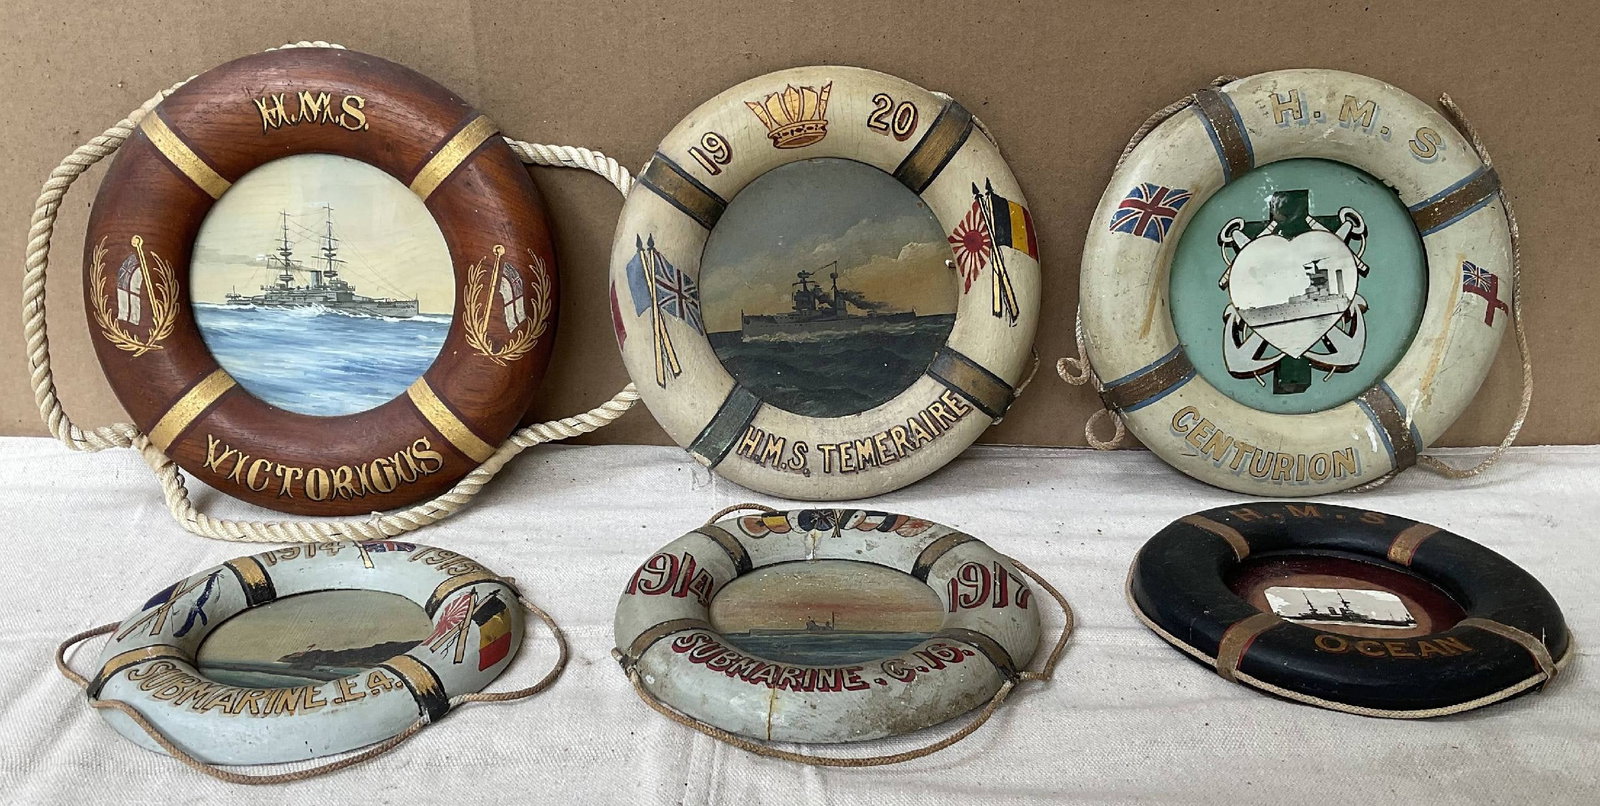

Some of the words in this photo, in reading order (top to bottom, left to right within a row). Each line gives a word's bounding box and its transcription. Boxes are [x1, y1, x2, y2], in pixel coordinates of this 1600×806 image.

[253, 91, 370, 134] H.M.S.
[866, 93, 918, 142] 20
[688, 131, 733, 176] 19
[818, 389, 974, 474] TEMERAIRE
[1170, 405, 1360, 485] CENTURION
[261, 541, 346, 567] 1914
[624, 551, 714, 608] 1914
[946, 560, 1033, 614] 1917
[1314, 634, 1473, 660] OCEAN
